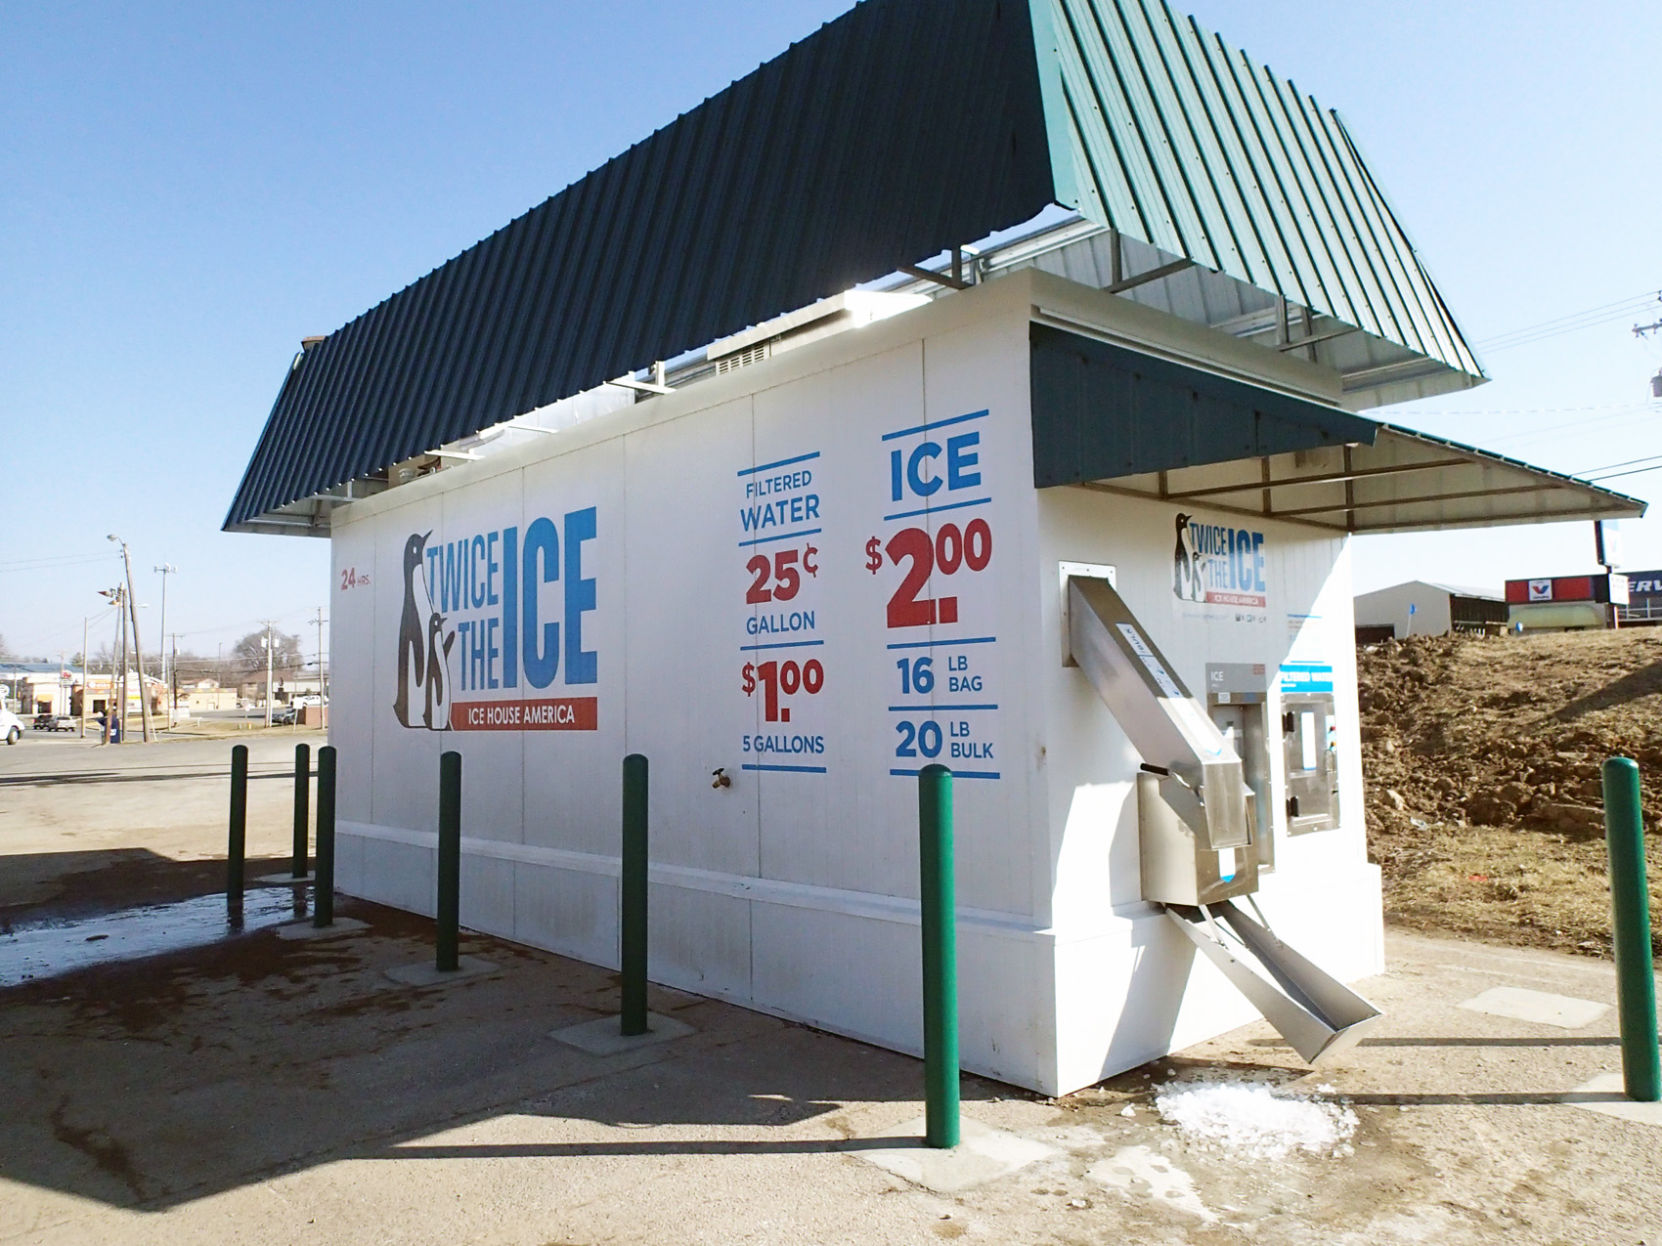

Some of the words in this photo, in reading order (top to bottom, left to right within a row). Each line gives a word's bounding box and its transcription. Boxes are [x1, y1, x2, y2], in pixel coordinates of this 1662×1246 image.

[890, 430, 982, 502] ICE
[746, 470, 812, 499] FILTERED
[739, 493, 820, 532] WATER
[1189, 522, 1226, 556] TWICE
[426, 531, 499, 613] TWICE
[1207, 558, 1227, 589] THE
[1227, 528, 1266, 592] ICE
[341, 567, 356, 590] 24
[502, 506, 598, 689] ICE
[746, 610, 816, 635] GALLON
[457, 618, 499, 691] THE
[897, 656, 935, 695] 16
[948, 655, 968, 671] LB
[948, 674, 983, 692] BAG
[1210, 671, 1224, 681] ICE
[468, 707, 485, 725] ICE
[487, 705, 521, 725] HOUSE
[523, 704, 575, 724] AMERICA
[743, 735, 751, 754] 5
[754, 735, 825, 754] GALLONS
[895, 720, 942, 759] 20
[950, 721, 970, 738] LB
[950, 741, 994, 759] BULK
